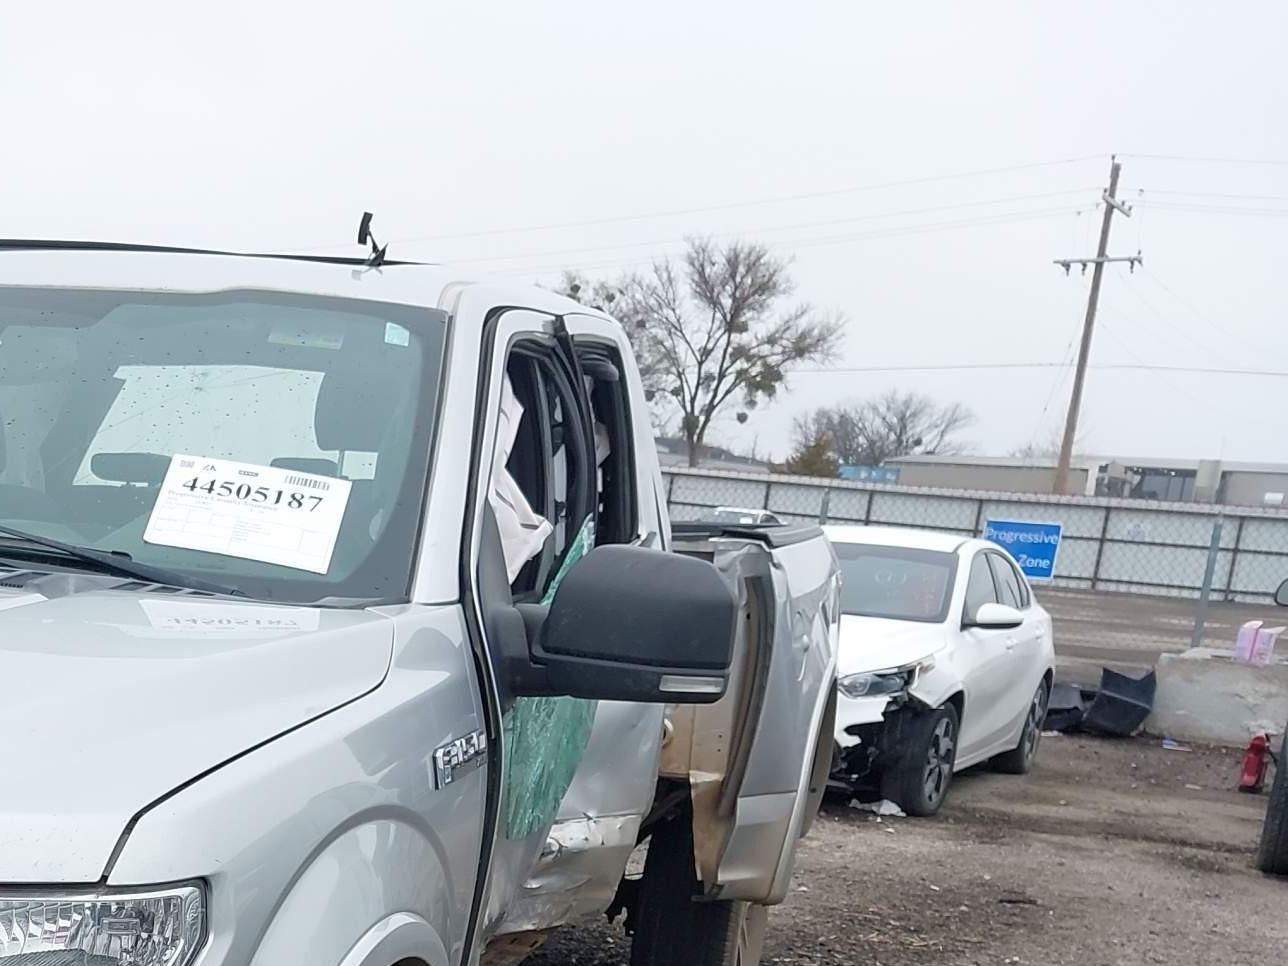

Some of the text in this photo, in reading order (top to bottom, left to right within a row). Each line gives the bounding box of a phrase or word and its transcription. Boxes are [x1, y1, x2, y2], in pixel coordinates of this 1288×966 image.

[182, 476, 323, 512] 44505187
[985, 527, 1059, 545] Progressive
[1019, 554, 1050, 569] Zone
